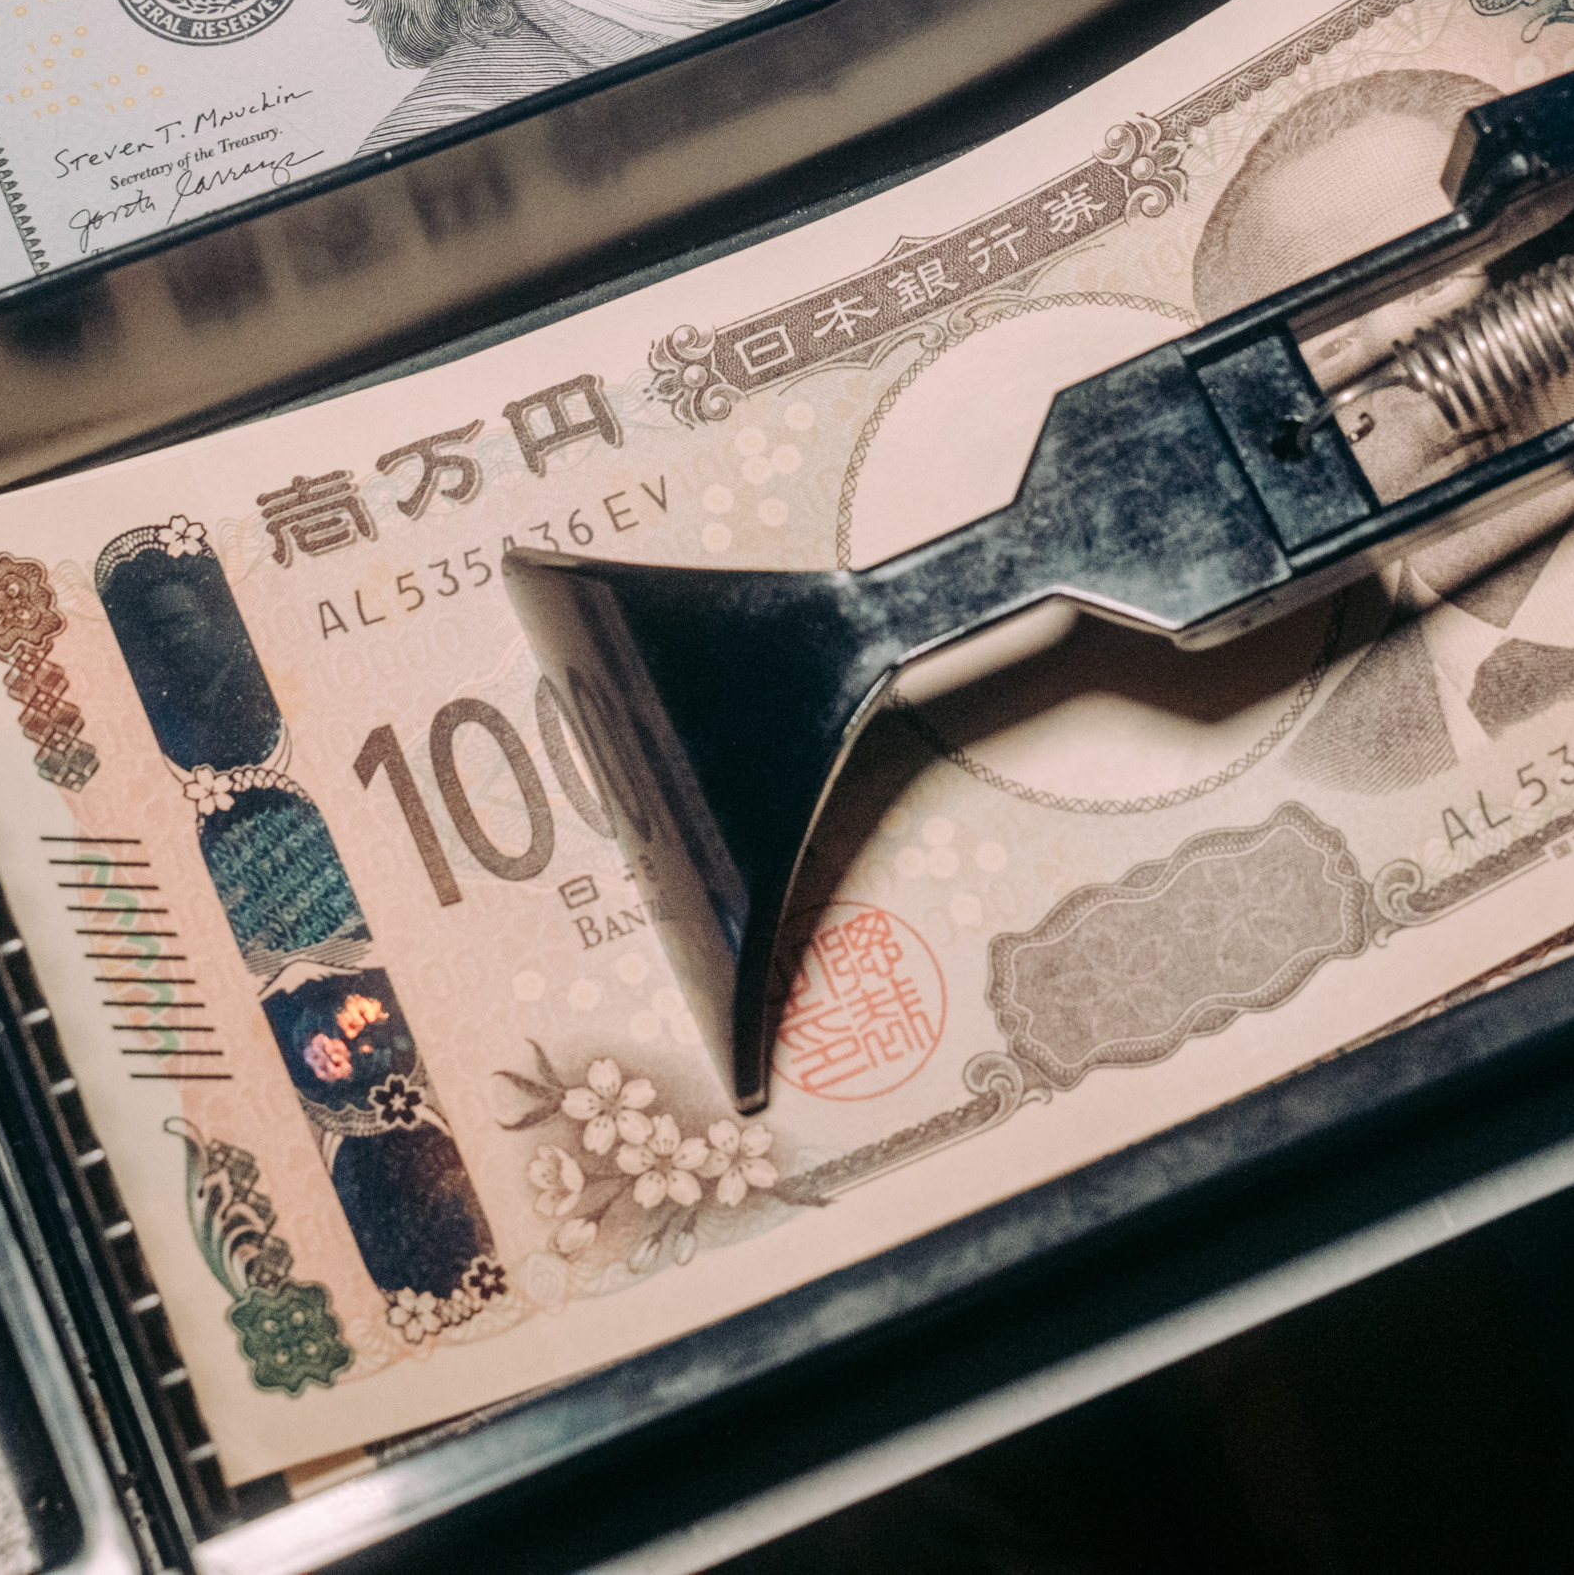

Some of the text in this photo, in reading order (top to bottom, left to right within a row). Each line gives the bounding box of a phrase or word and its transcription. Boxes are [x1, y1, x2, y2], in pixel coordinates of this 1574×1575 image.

[110, 126, 284, 191] Secretary of the Treasury.
[731, 176, 1110, 377] 日本銀行券
[574, 900, 651, 951] BAN
